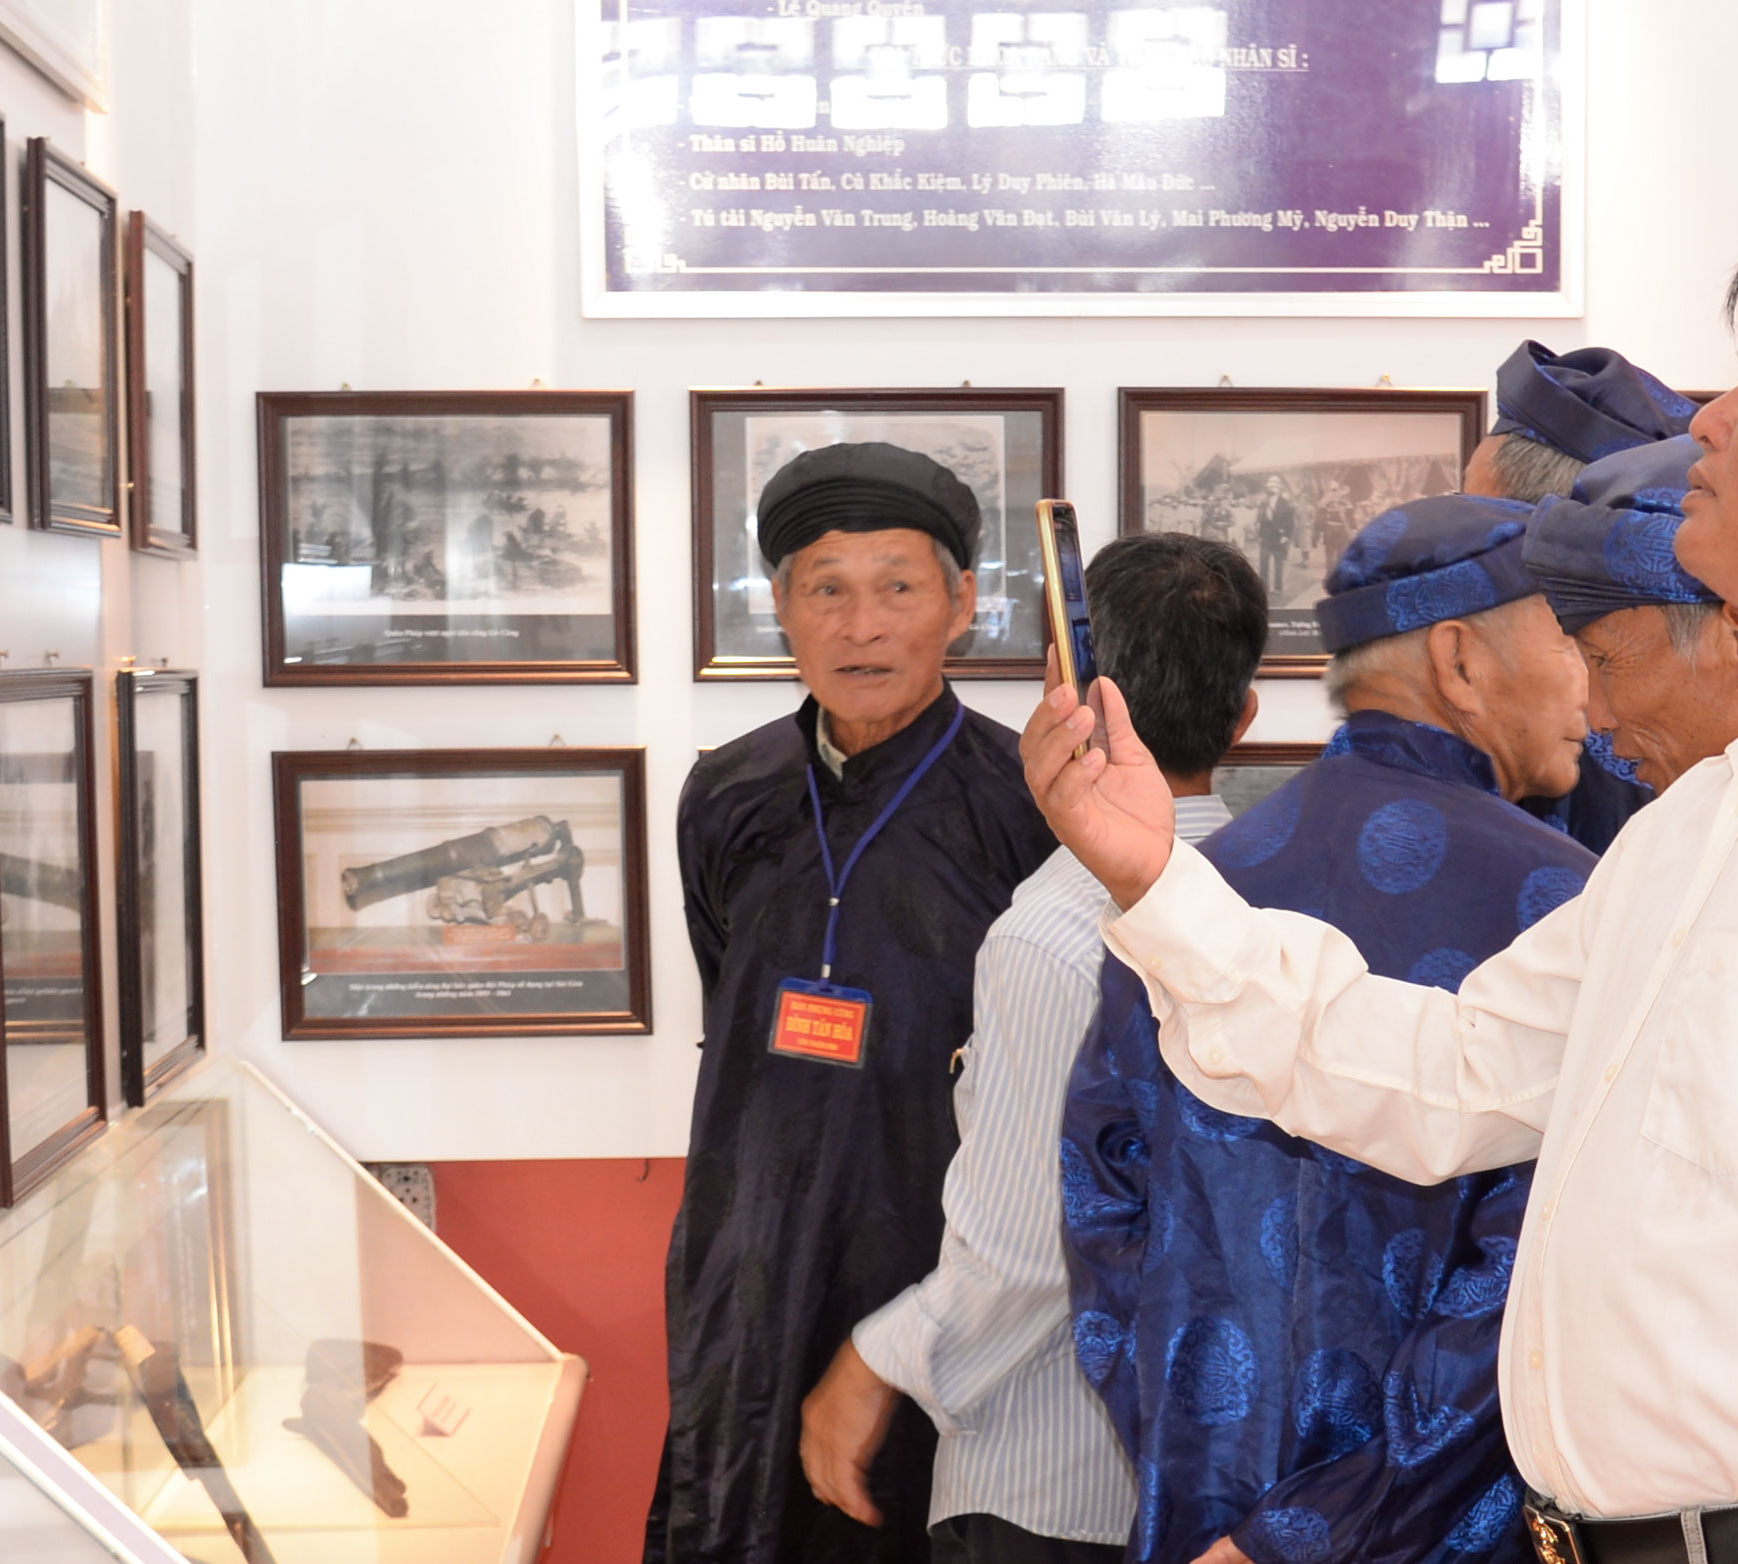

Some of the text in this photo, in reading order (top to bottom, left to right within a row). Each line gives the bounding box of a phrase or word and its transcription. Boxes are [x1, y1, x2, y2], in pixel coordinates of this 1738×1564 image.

[844, 135, 905, 157] Nghiệp
[998, 173, 1031, 194] Duy
[750, 205, 816, 231] Nguyễn
[821, 209, 856, 226] Văn
[924, 209, 979, 231] Hoàng
[1172, 209, 1204, 226] Mai
[1209, 209, 1273, 231] Phương
[1315, 206, 1380, 231] Nguyễn
[1384, 210, 1419, 231] Duy
